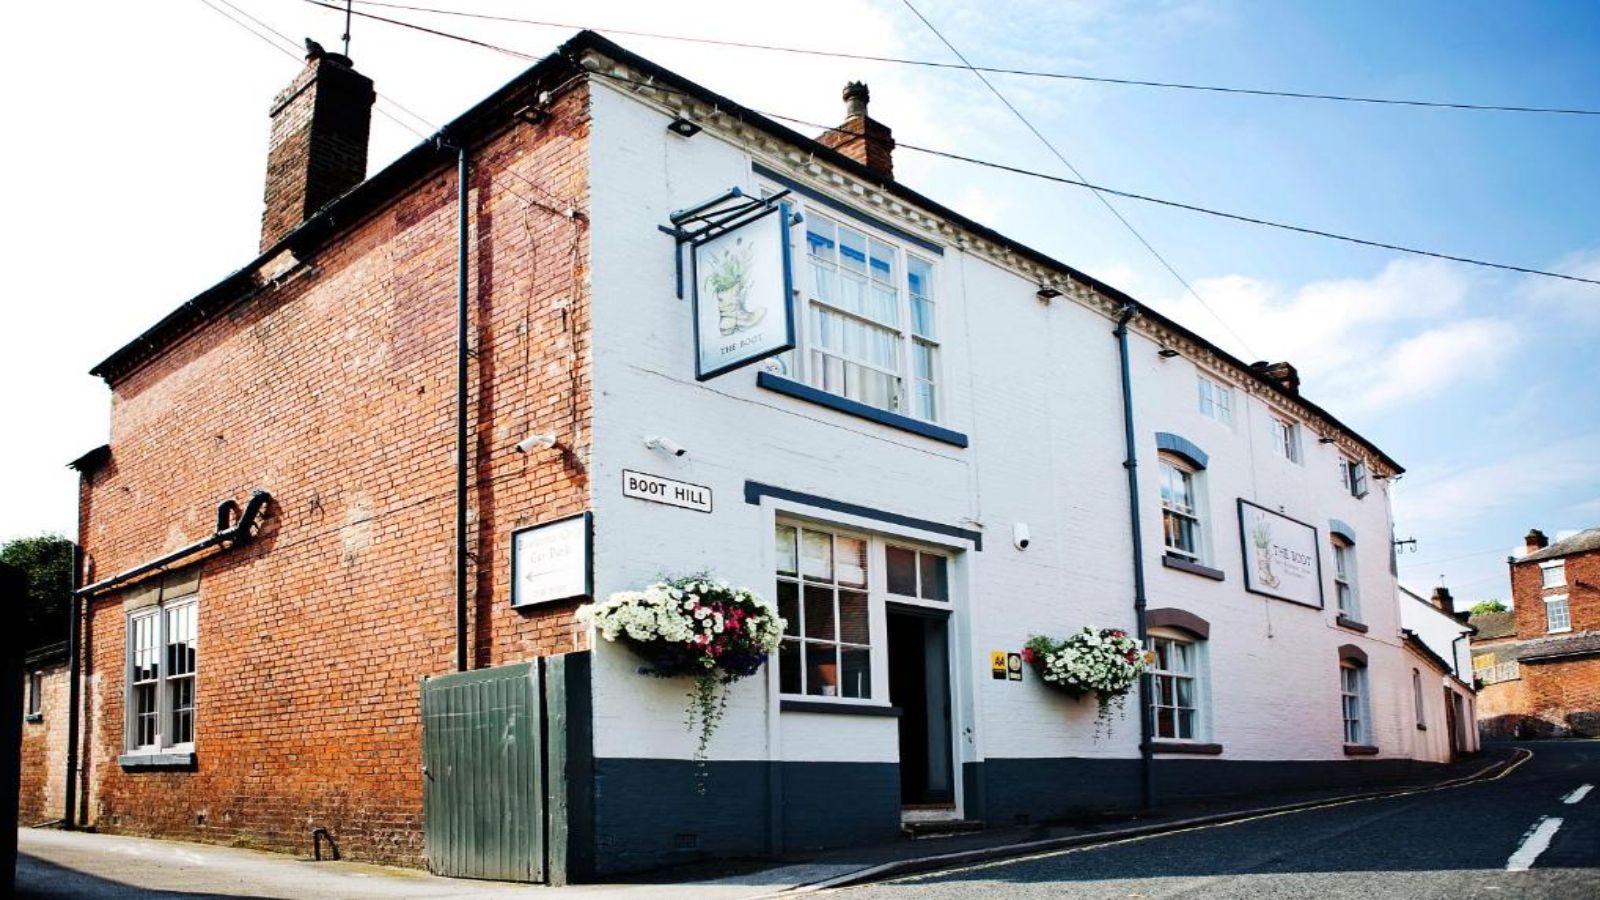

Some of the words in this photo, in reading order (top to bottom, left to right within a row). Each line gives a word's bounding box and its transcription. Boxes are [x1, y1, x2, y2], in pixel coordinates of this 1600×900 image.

[720, 343, 737, 355] THE
[740, 334, 763, 348] BOOT
[629, 477, 667, 497] BOOT
[675, 486, 707, 505] HILL
[1272, 544, 1290, 560] THE
[1291, 550, 1312, 567] BOOT
